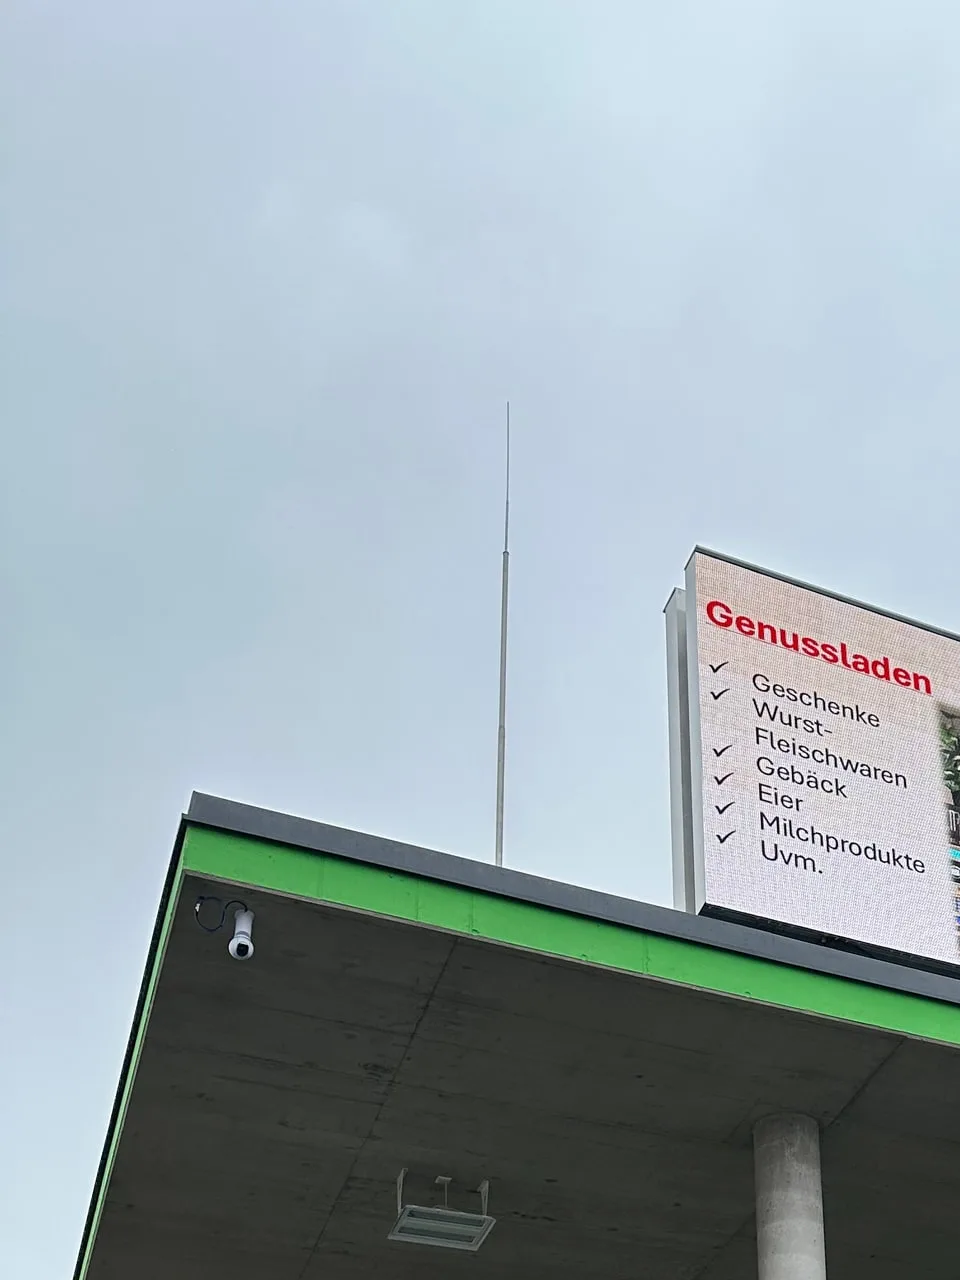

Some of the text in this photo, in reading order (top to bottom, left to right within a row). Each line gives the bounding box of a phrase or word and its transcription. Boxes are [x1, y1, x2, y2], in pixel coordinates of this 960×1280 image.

[706, 600, 932, 694] Genussladen
[752, 673, 880, 728] Geschenke
[752, 698, 833, 737] Wurst-
[755, 727, 908, 788] Fleischwaren
[756, 756, 848, 798] Gebäck
[758, 783, 803, 811] Eier
[760, 811, 925, 873] Milchprodukte
[761, 839, 823, 874] Uvm.
